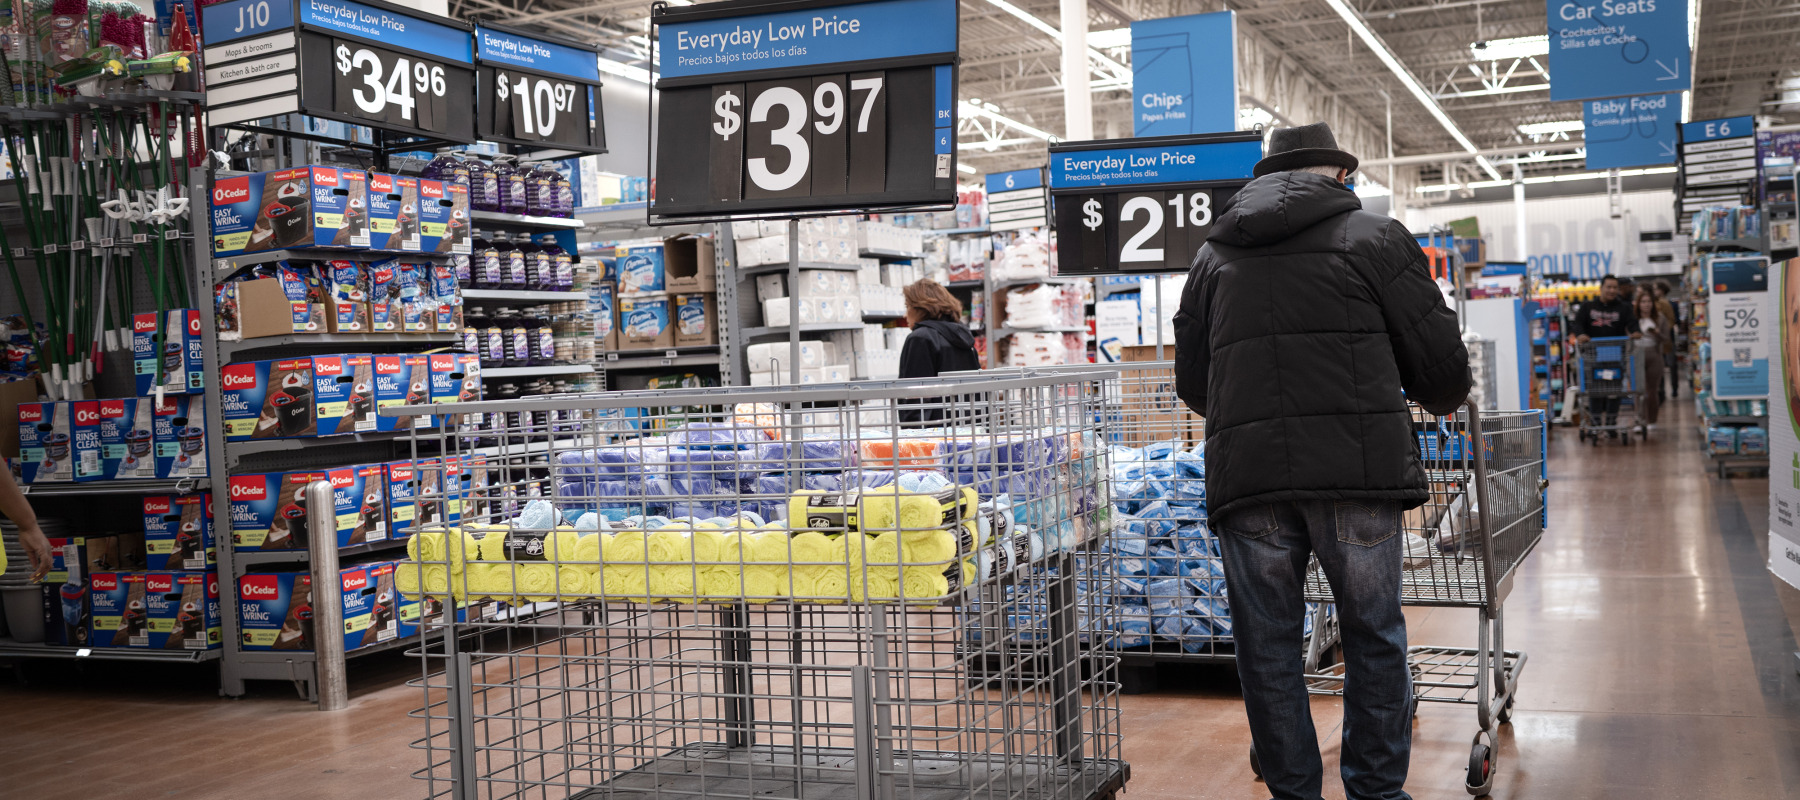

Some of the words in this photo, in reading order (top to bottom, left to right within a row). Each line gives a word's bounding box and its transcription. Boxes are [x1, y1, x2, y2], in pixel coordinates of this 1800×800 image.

[1560, 4, 1596, 20] Car
[1602, 0, 1656, 16] Seats
[234, 1, 270, 33] J10
[311, 0, 358, 23] Everyday
[360, 9, 379, 26] Low
[382, 15, 405, 32] Price
[312, 12, 332, 24] Precios
[332, 18, 346, 28] bajos
[347, 22, 361, 32] todos
[678, 26, 762, 52] Everyday
[768, 22, 805, 42] Low
[812, 16, 860, 36] Price
[1560, 26, 1616, 38] Cochecitos
[1619, 25, 1625, 34] y
[484, 34, 517, 54] Everyday
[518, 41, 532, 54] Low
[534, 44, 551, 58] Price
[1560, 39, 1585, 49] Sillas
[1588, 37, 1600, 46] de
[1603, 34, 1636, 45] Coche
[225, 48, 242, 58] Mops
[243, 46, 248, 54] &
[248, 42, 273, 53] brooms
[678, 55, 712, 66] Precios
[715, 52, 740, 65] bajos
[742, 48, 770, 60] todos
[772, 48, 786, 58] los
[788, 45, 807, 56] días
[220, 70, 244, 80] Kitchen
[245, 66, 250, 74] &
[252, 65, 265, 74] bath
[266, 62, 280, 70] care
[1142, 93, 1183, 110] Chips
[1592, 100, 1626, 116] Baby
[1631, 96, 1666, 111] Food
[938, 110, 950, 118] BK
[1142, 113, 1164, 122] Papas
[1165, 111, 1186, 120] Fritas
[1705, 124, 1716, 138] E
[1720, 122, 1730, 136] 6
[940, 137, 946, 146] 6
[1064, 156, 1126, 172] Everyday
[1130, 154, 1157, 168] Low
[1162, 152, 1196, 166] Price
[315, 174, 336, 182] O-Cedar
[1005, 174, 1014, 188] 6
[1065, 174, 1090, 182] Precios
[1092, 172, 1110, 182] bajos
[1111, 171, 1131, 179] todos
[1132, 170, 1143, 178] los
[371, 180, 391, 189] O-Cedar
[215, 188, 247, 201] O-Cedar
[422, 186, 441, 194] O-Cedar
[315, 195, 336, 203] WRING
[371, 194, 383, 202] EASY
[214, 208, 231, 218] EASY
[422, 206, 441, 214] WRING
[215, 215, 240, 227] WRING
[1528, 251, 1613, 280] POULTRY
[1724, 308, 1759, 329] 5%
[135, 321, 155, 330] O-Cedar
[190, 351, 203, 359] CLE
[317, 364, 340, 372] O-Cedar
[378, 363, 399, 371] O-Cedar
[433, 361, 453, 369] O-Cedar
[224, 374, 254, 386] O-Cedar
[317, 385, 340, 393] WRING
[224, 394, 240, 402] EASY
[224, 402, 248, 411] WRING
[77, 410, 99, 422] O-Ce
[76, 432, 98, 441] RINSE
[77, 440, 102, 449] CLEAN
[392, 470, 411, 479] O-Cedar
[331, 477, 352, 485] O-Cedar
[232, 485, 264, 496] O-Cedar
[391, 484, 404, 492] EASY
[392, 490, 410, 498] WRING
[232, 505, 248, 513] EASY
[232, 513, 258, 521] WRING
[93, 580, 115, 588] O-Cedar
[147, 581, 170, 589] O-Cedar
[344, 578, 365, 588] O-Cedar
[243, 584, 276, 595] O-Cedar
[344, 593, 358, 601] EASY
[344, 599, 364, 609] WRING
[243, 612, 269, 620] WRING
